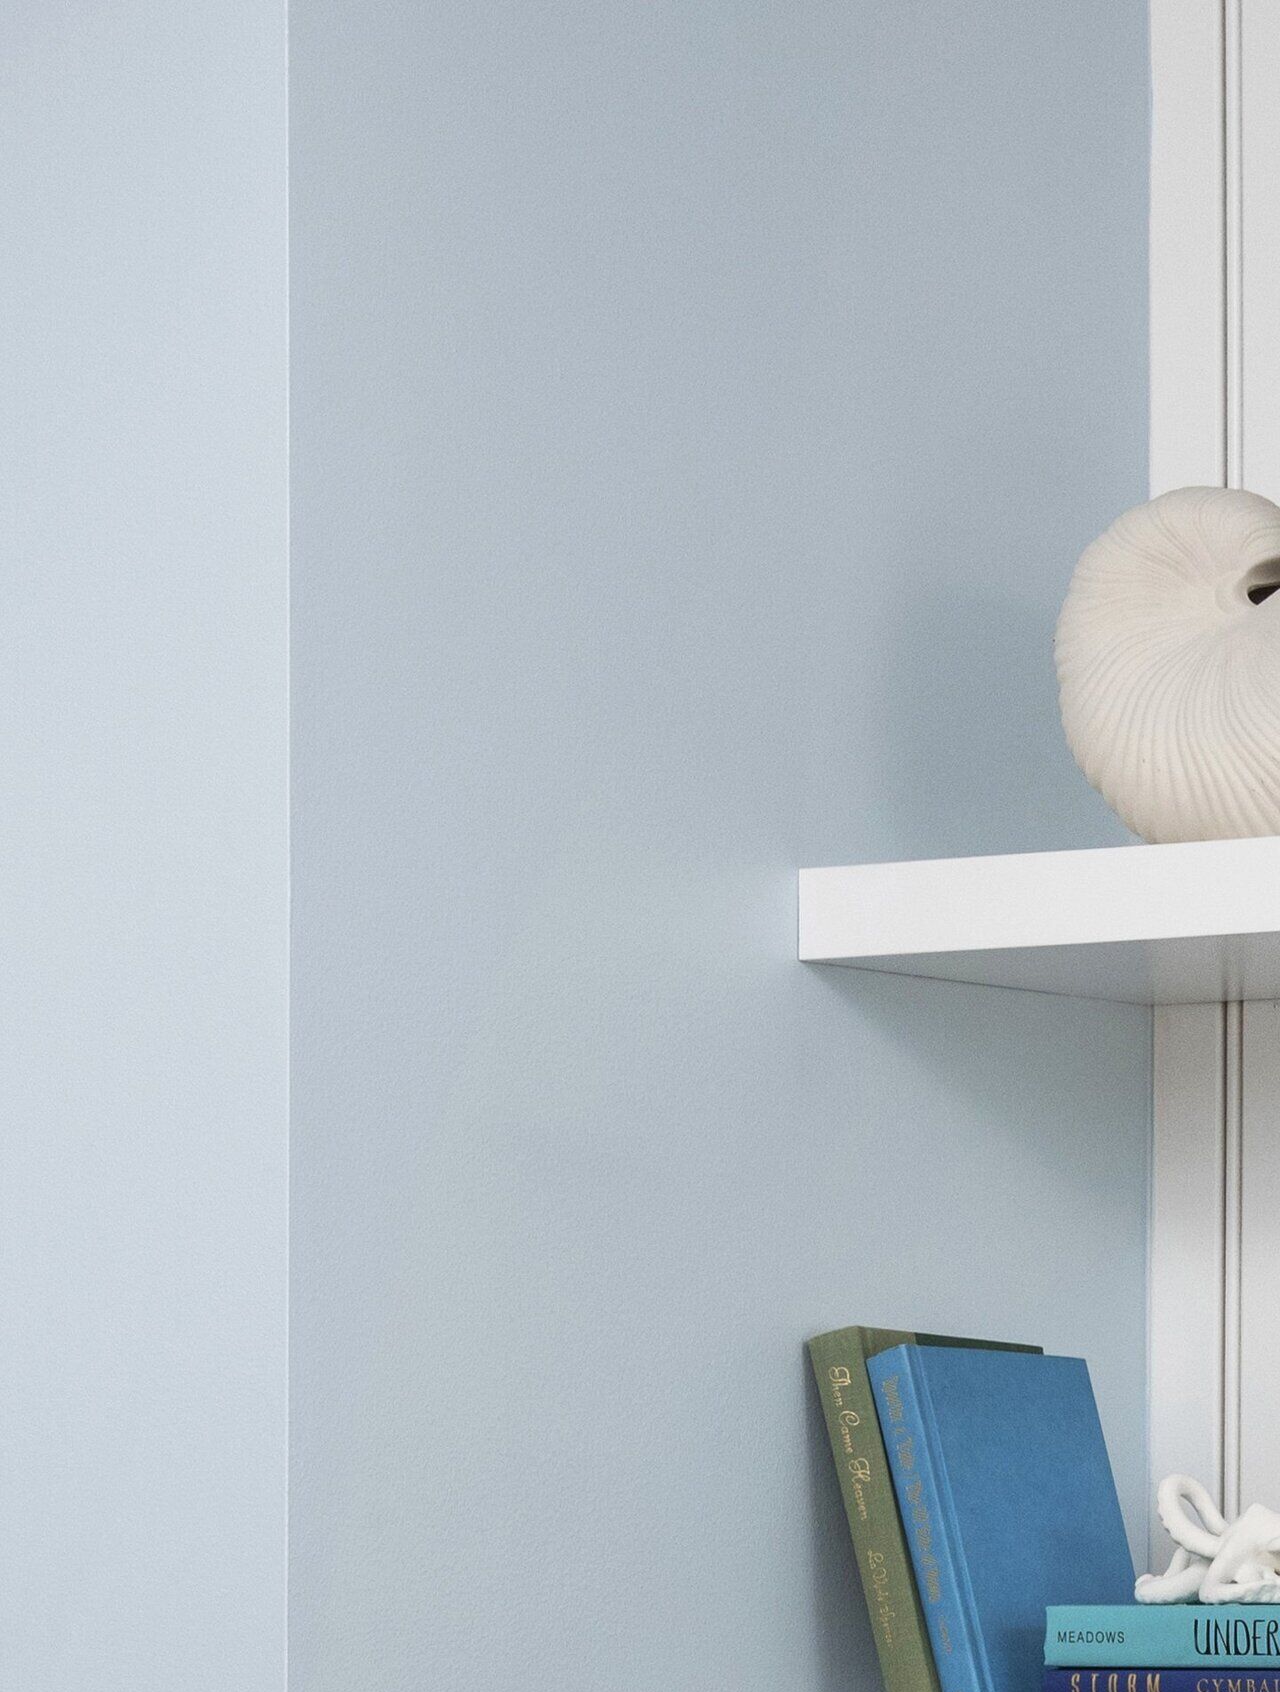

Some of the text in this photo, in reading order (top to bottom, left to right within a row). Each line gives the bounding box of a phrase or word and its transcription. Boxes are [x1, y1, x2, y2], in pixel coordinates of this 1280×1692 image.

[828, 1365, 871, 1520] Then Came Heaven
[1057, 1630, 1125, 1644] MEADOWS
